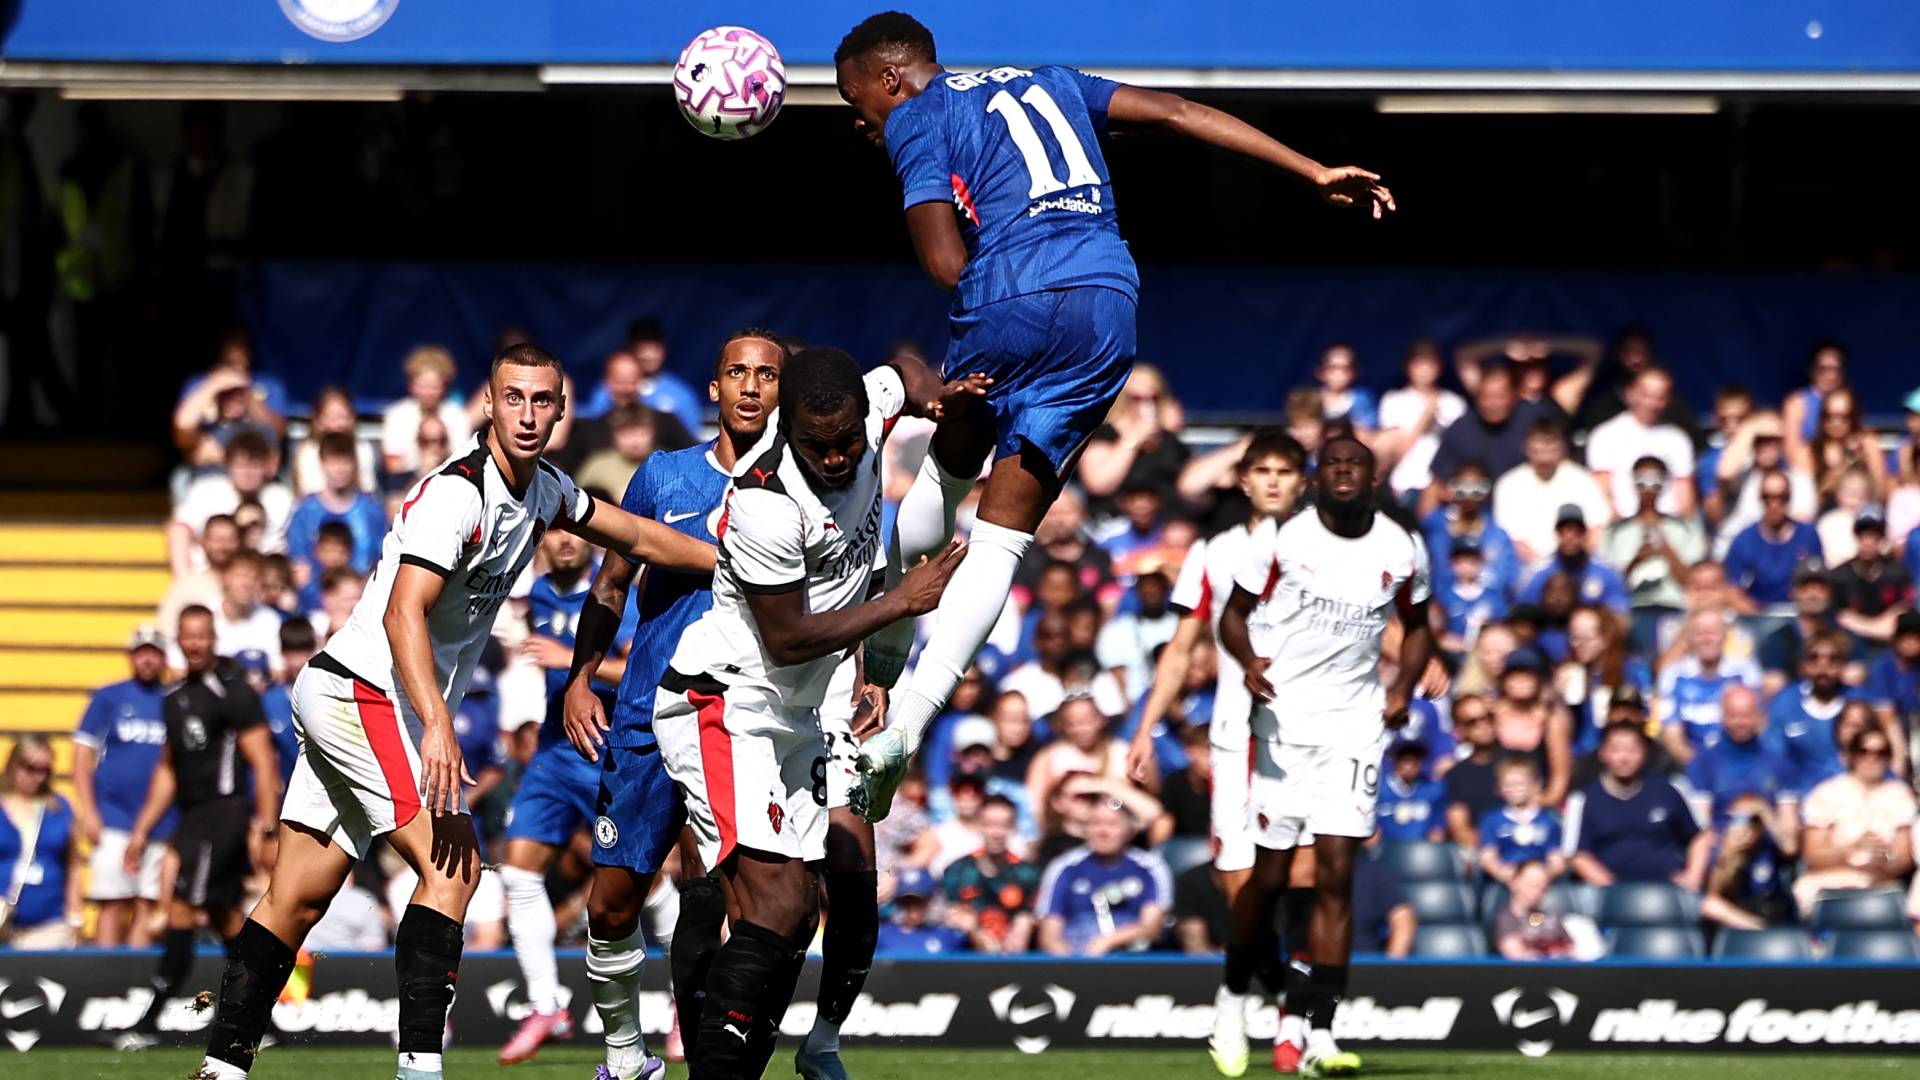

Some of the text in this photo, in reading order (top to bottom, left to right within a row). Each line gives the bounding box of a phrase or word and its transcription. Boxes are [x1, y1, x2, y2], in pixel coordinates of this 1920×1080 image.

[986, 83, 1101, 199] 11
[810, 755, 828, 807] 8
[1349, 757, 1378, 797] 19
[1590, 999, 1726, 1042] nike
